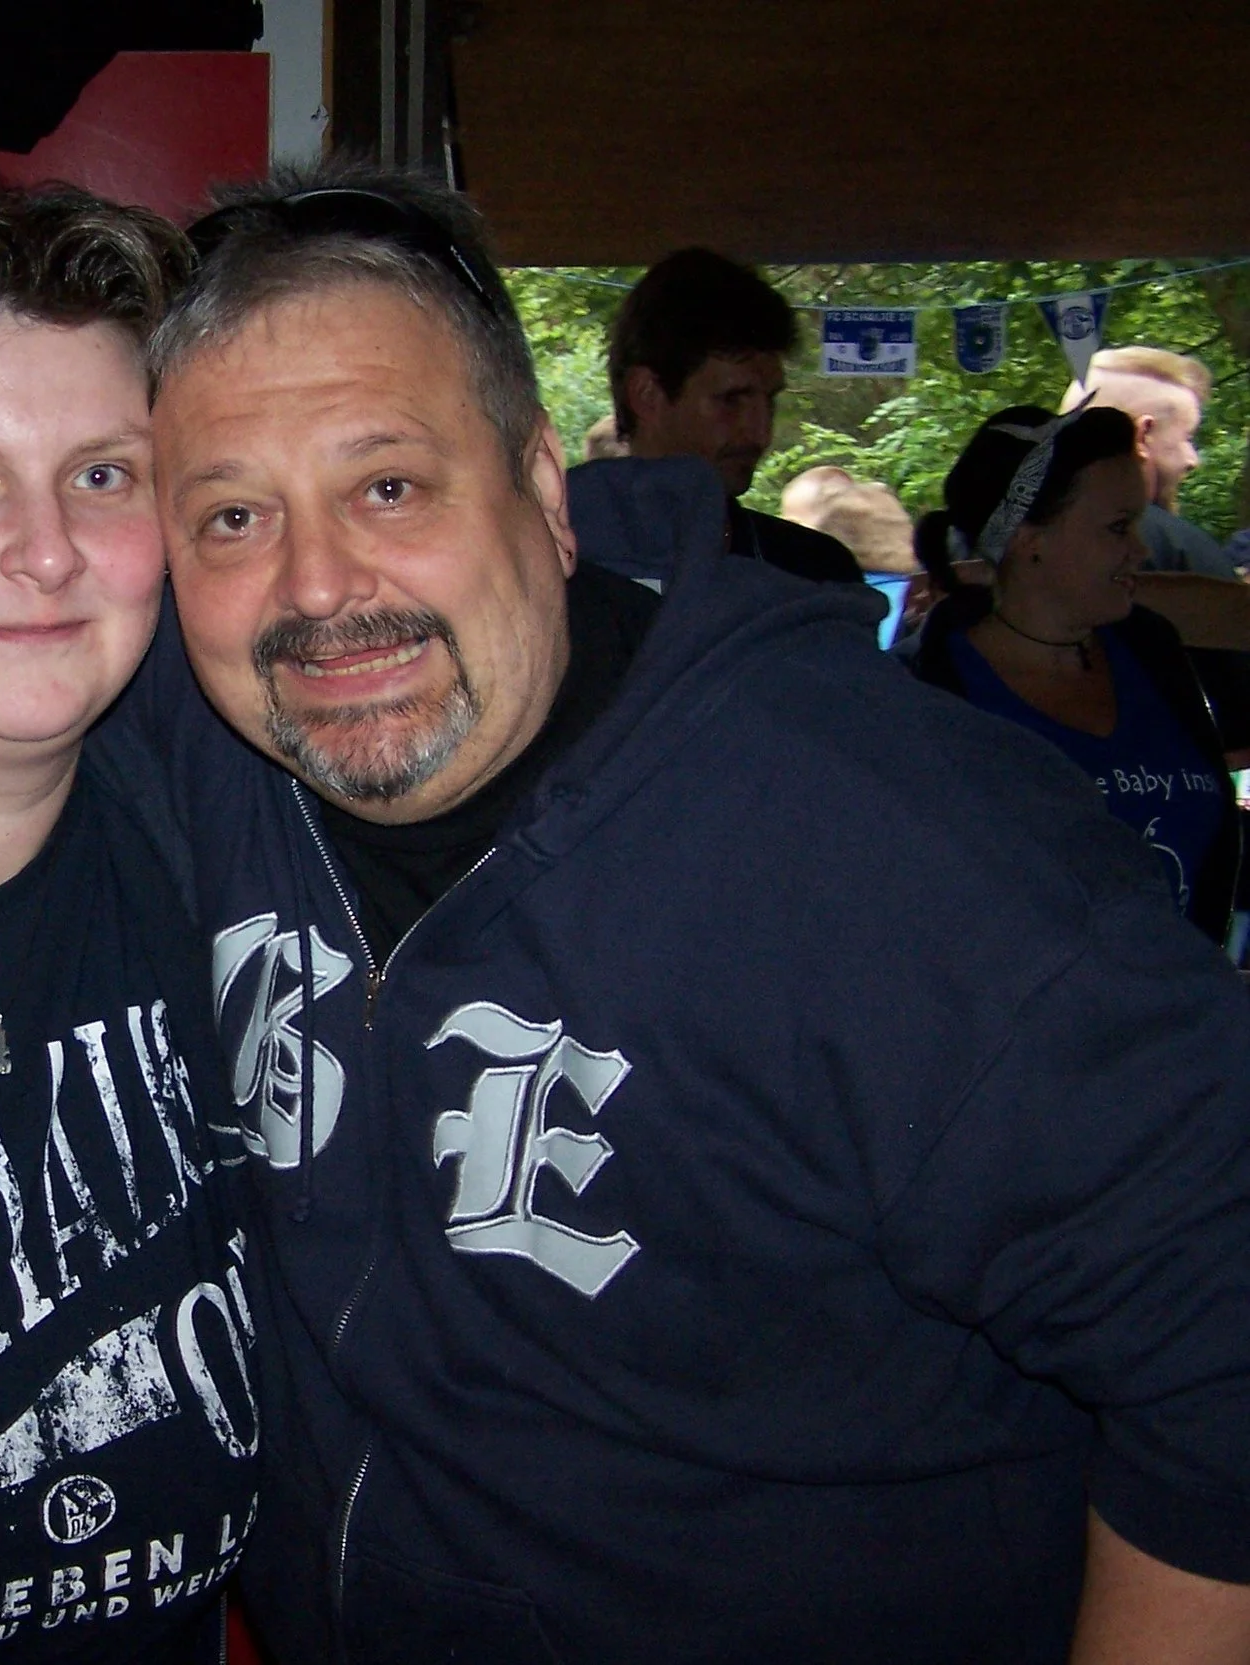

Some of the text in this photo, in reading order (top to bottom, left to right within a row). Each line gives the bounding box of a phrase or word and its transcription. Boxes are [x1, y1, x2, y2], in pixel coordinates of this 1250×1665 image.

[1112, 765, 1174, 801] Baby
[424, 1000, 641, 1299] E
[41, 1595, 130, 1630] UND
